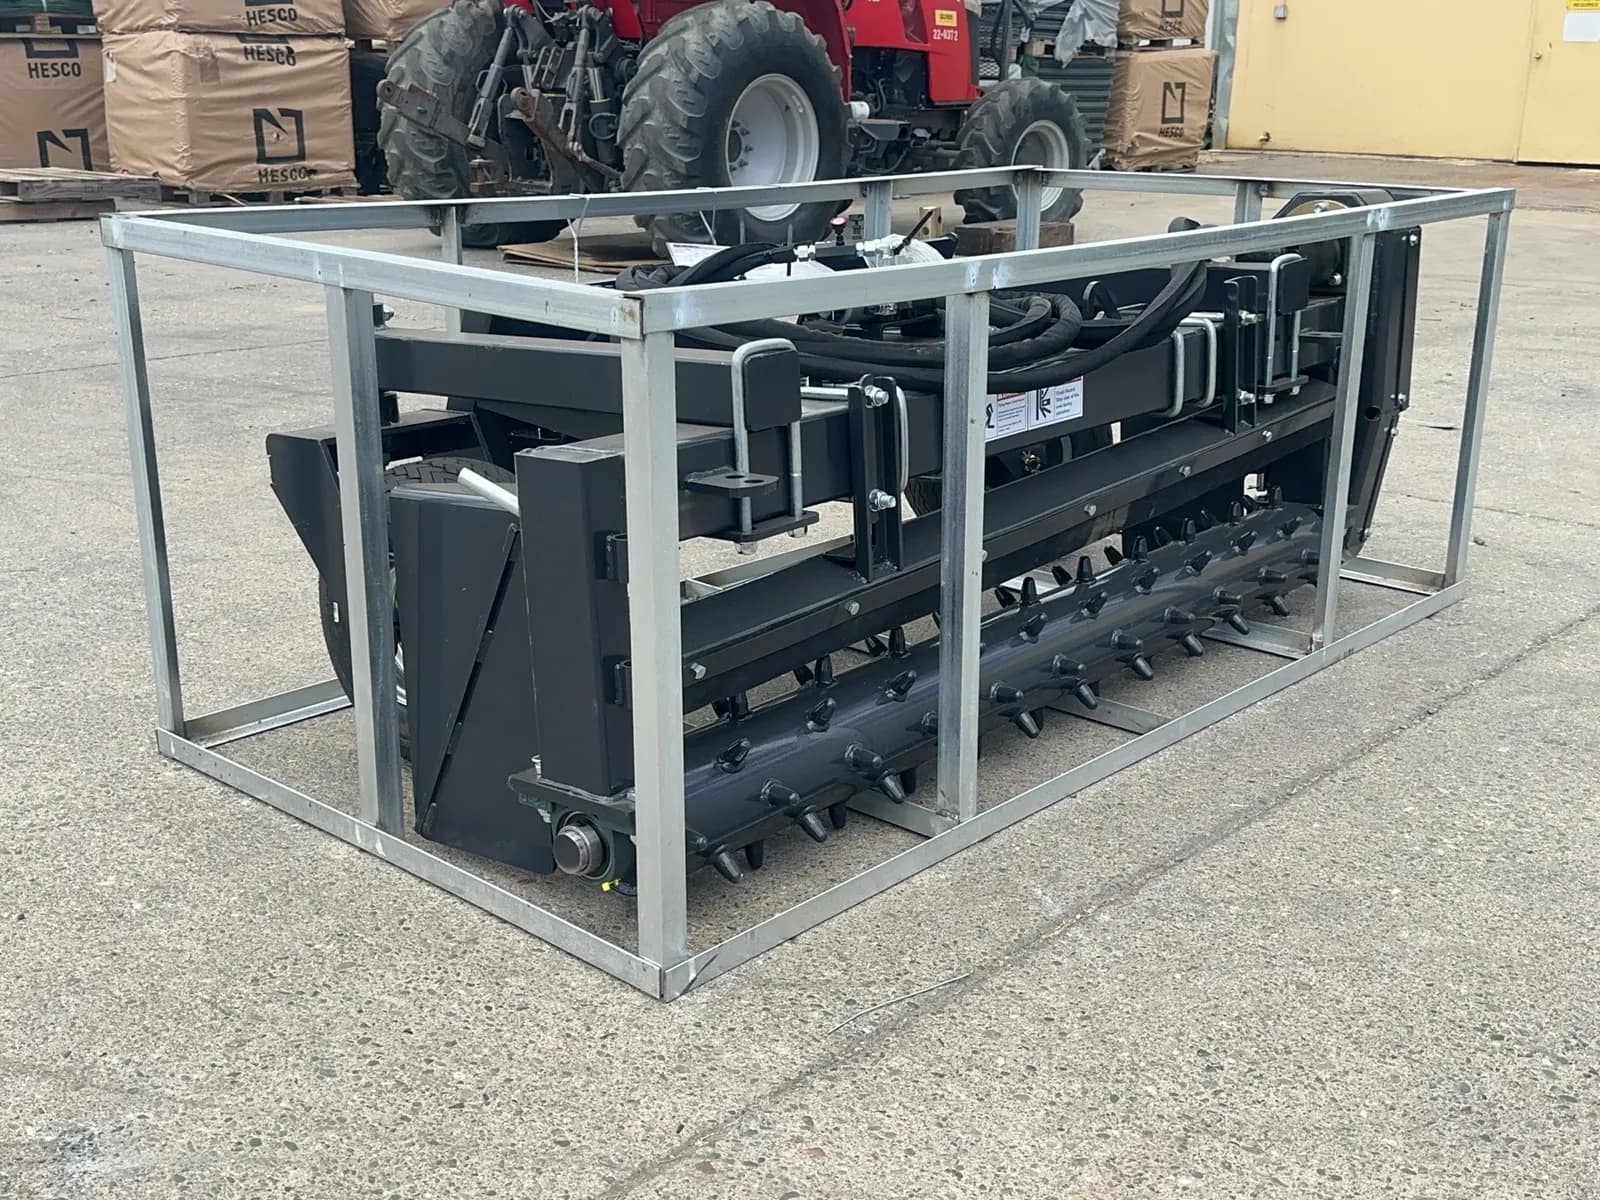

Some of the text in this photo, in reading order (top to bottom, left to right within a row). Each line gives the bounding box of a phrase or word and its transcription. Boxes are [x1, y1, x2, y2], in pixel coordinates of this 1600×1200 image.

[245, 8, 298, 26] HESCO
[244, 46, 297, 66] HESCO
[27, 62, 82, 78] HESCO
[1158, 126, 1185, 138] HESCO
[257, 166, 307, 184] HESCO
